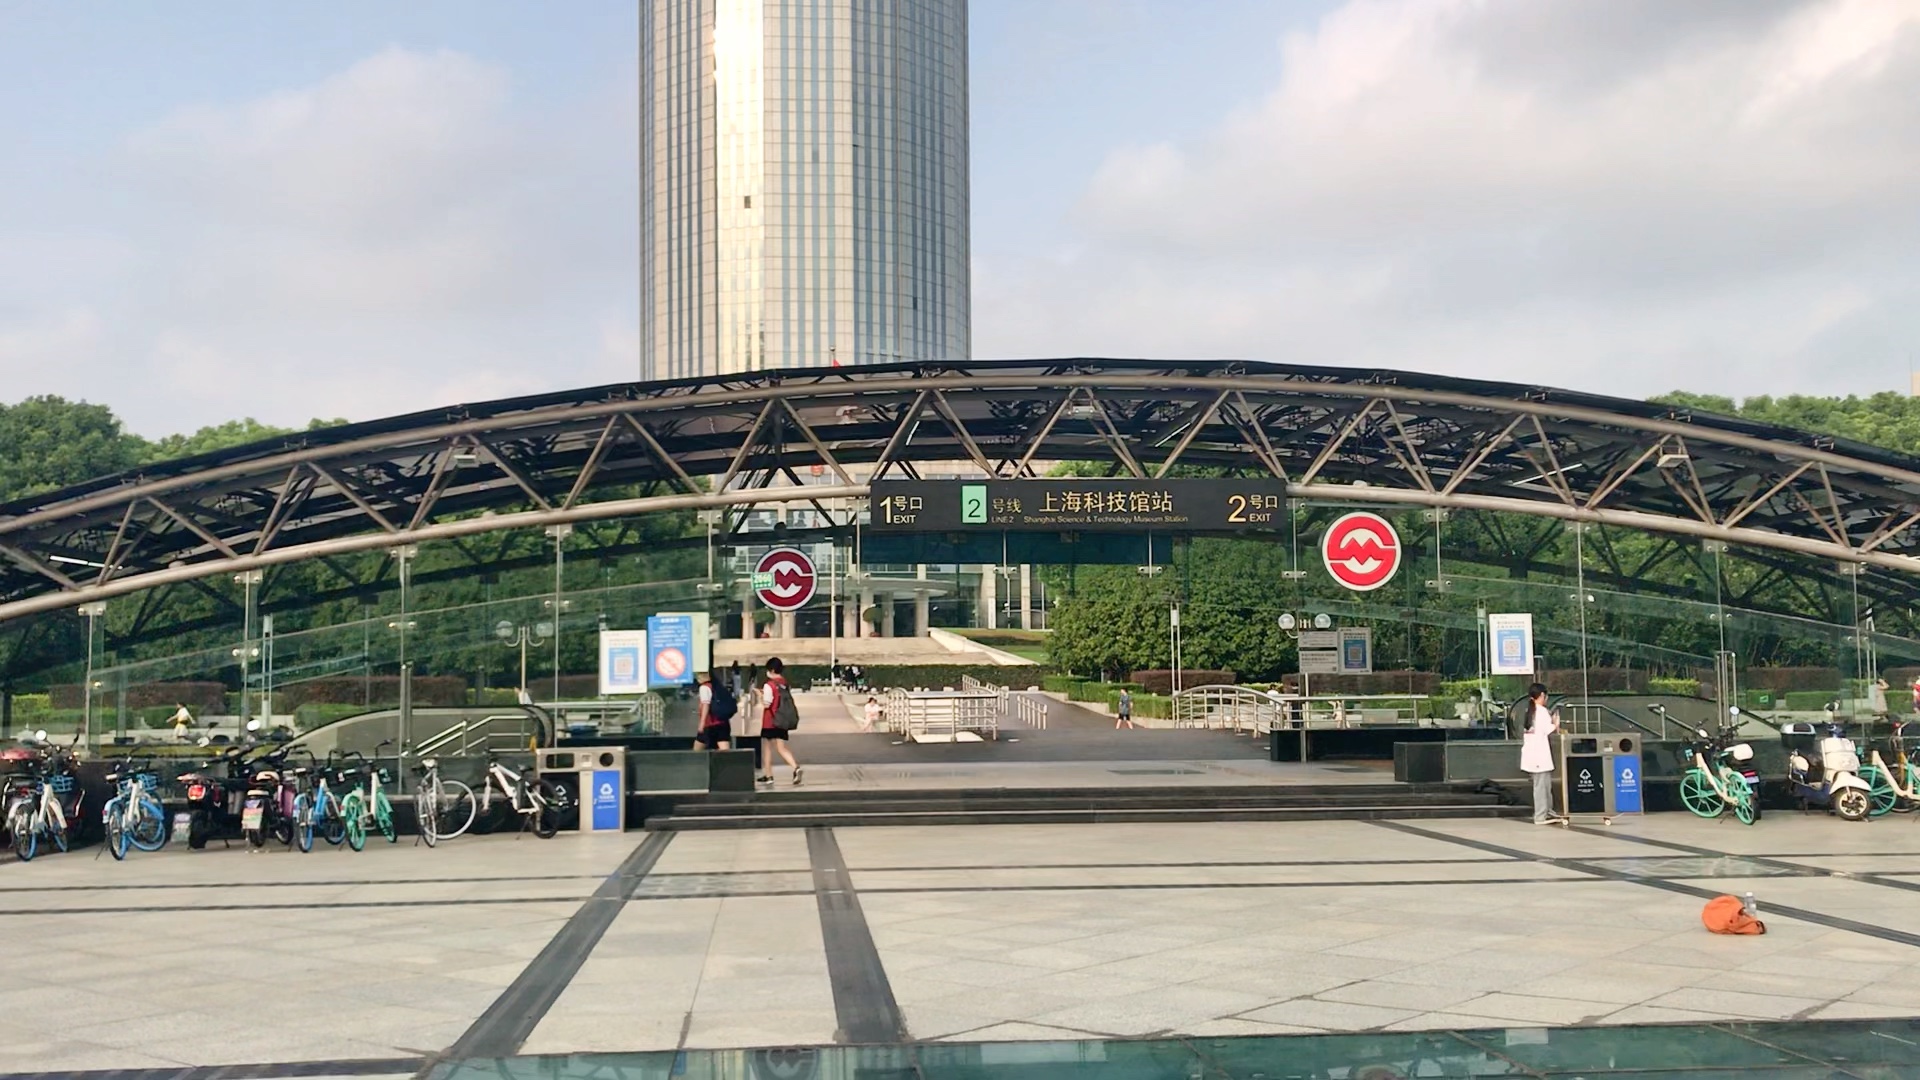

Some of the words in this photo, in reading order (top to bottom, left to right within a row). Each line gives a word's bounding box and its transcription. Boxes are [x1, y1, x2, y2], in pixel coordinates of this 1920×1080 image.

[880, 496, 892, 523] 1
[968, 499, 981, 518] 2
[992, 499, 1022, 513] 号线
[1039, 491, 1173, 513] 上海科技馆站
[1227, 495, 1247, 523] 2
[893, 515, 916, 523] EXIT
[1023, 516, 1056, 524] Shanghai
[1093, 515, 1132, 524] Technology
[1134, 515, 1163, 523] Museum
[1249, 513, 1271, 522] EXIT
